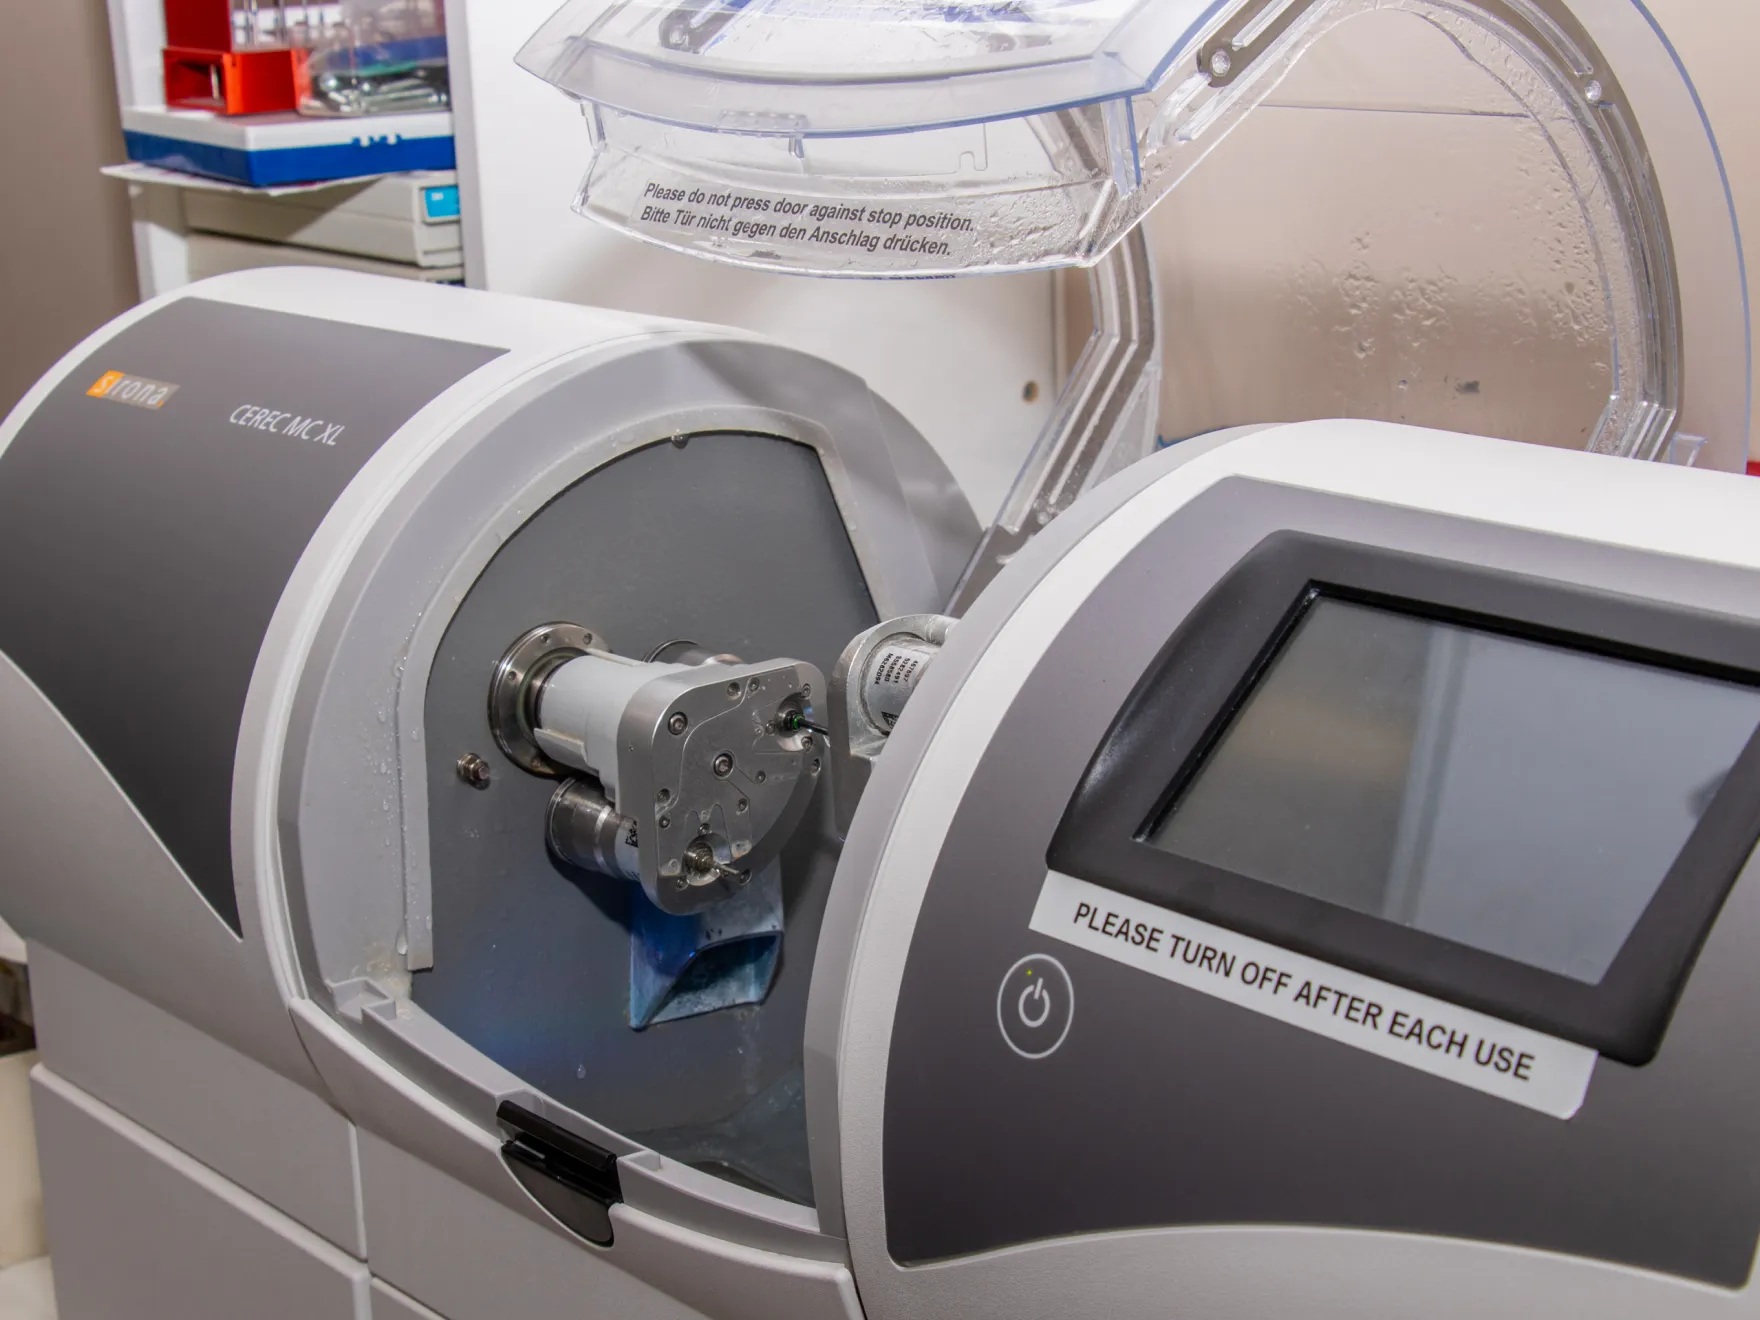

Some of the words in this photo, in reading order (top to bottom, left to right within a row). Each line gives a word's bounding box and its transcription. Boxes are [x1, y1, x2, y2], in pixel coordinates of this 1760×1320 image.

[641, 206, 671, 224] Bitte
[673, 209, 696, 227] Tür
[697, 214, 732, 233] nicht
[732, 221, 777, 239] gegen
[778, 223, 807, 240] den
[808, 226, 879, 252] Anschlag
[883, 234, 951, 256] drücken.
[643, 183, 686, 201] Please
[687, 188, 705, 205] do
[706, 191, 732, 207] not
[731, 194, 771, 212] press
[773, 197, 809, 215] door
[809, 203, 866, 223] against
[867, 207, 902, 228] stop
[903, 211, 974, 232] position.
[229, 404, 290, 433] CEREC
[282, 415, 323, 440] MC
[313, 423, 345, 446] XL
[1073, 902, 1164, 952] PLEASE
[1171, 934, 1236, 978] TURN
[1241, 961, 1293, 996] OFF
[1294, 981, 1383, 1030] AFTER
[1388, 1011, 1469, 1059] EACH
[1473, 1039, 1536, 1081] USE
